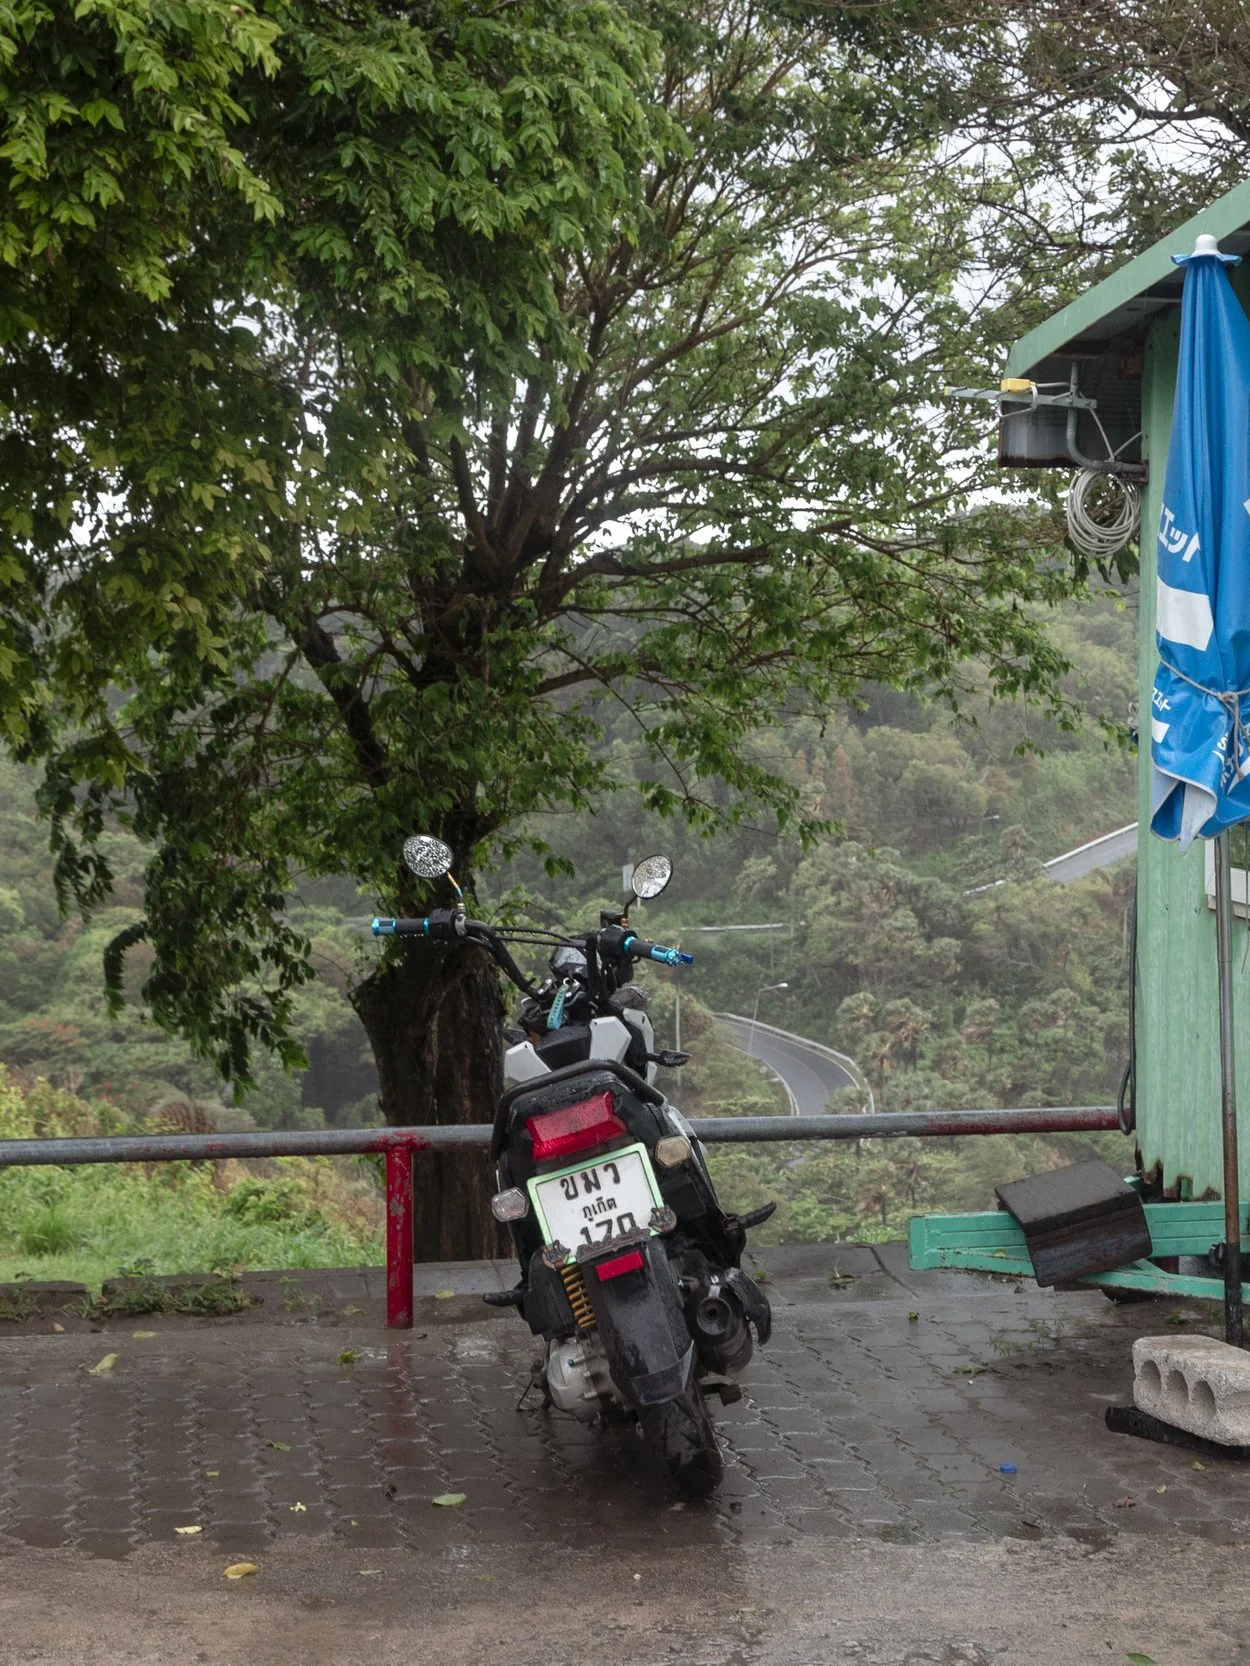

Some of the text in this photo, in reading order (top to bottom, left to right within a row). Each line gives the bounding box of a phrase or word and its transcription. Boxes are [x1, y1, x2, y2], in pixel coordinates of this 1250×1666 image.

[560, 1163, 621, 1200] ขมว
[582, 1196, 617, 1222] ภูเก็ต
